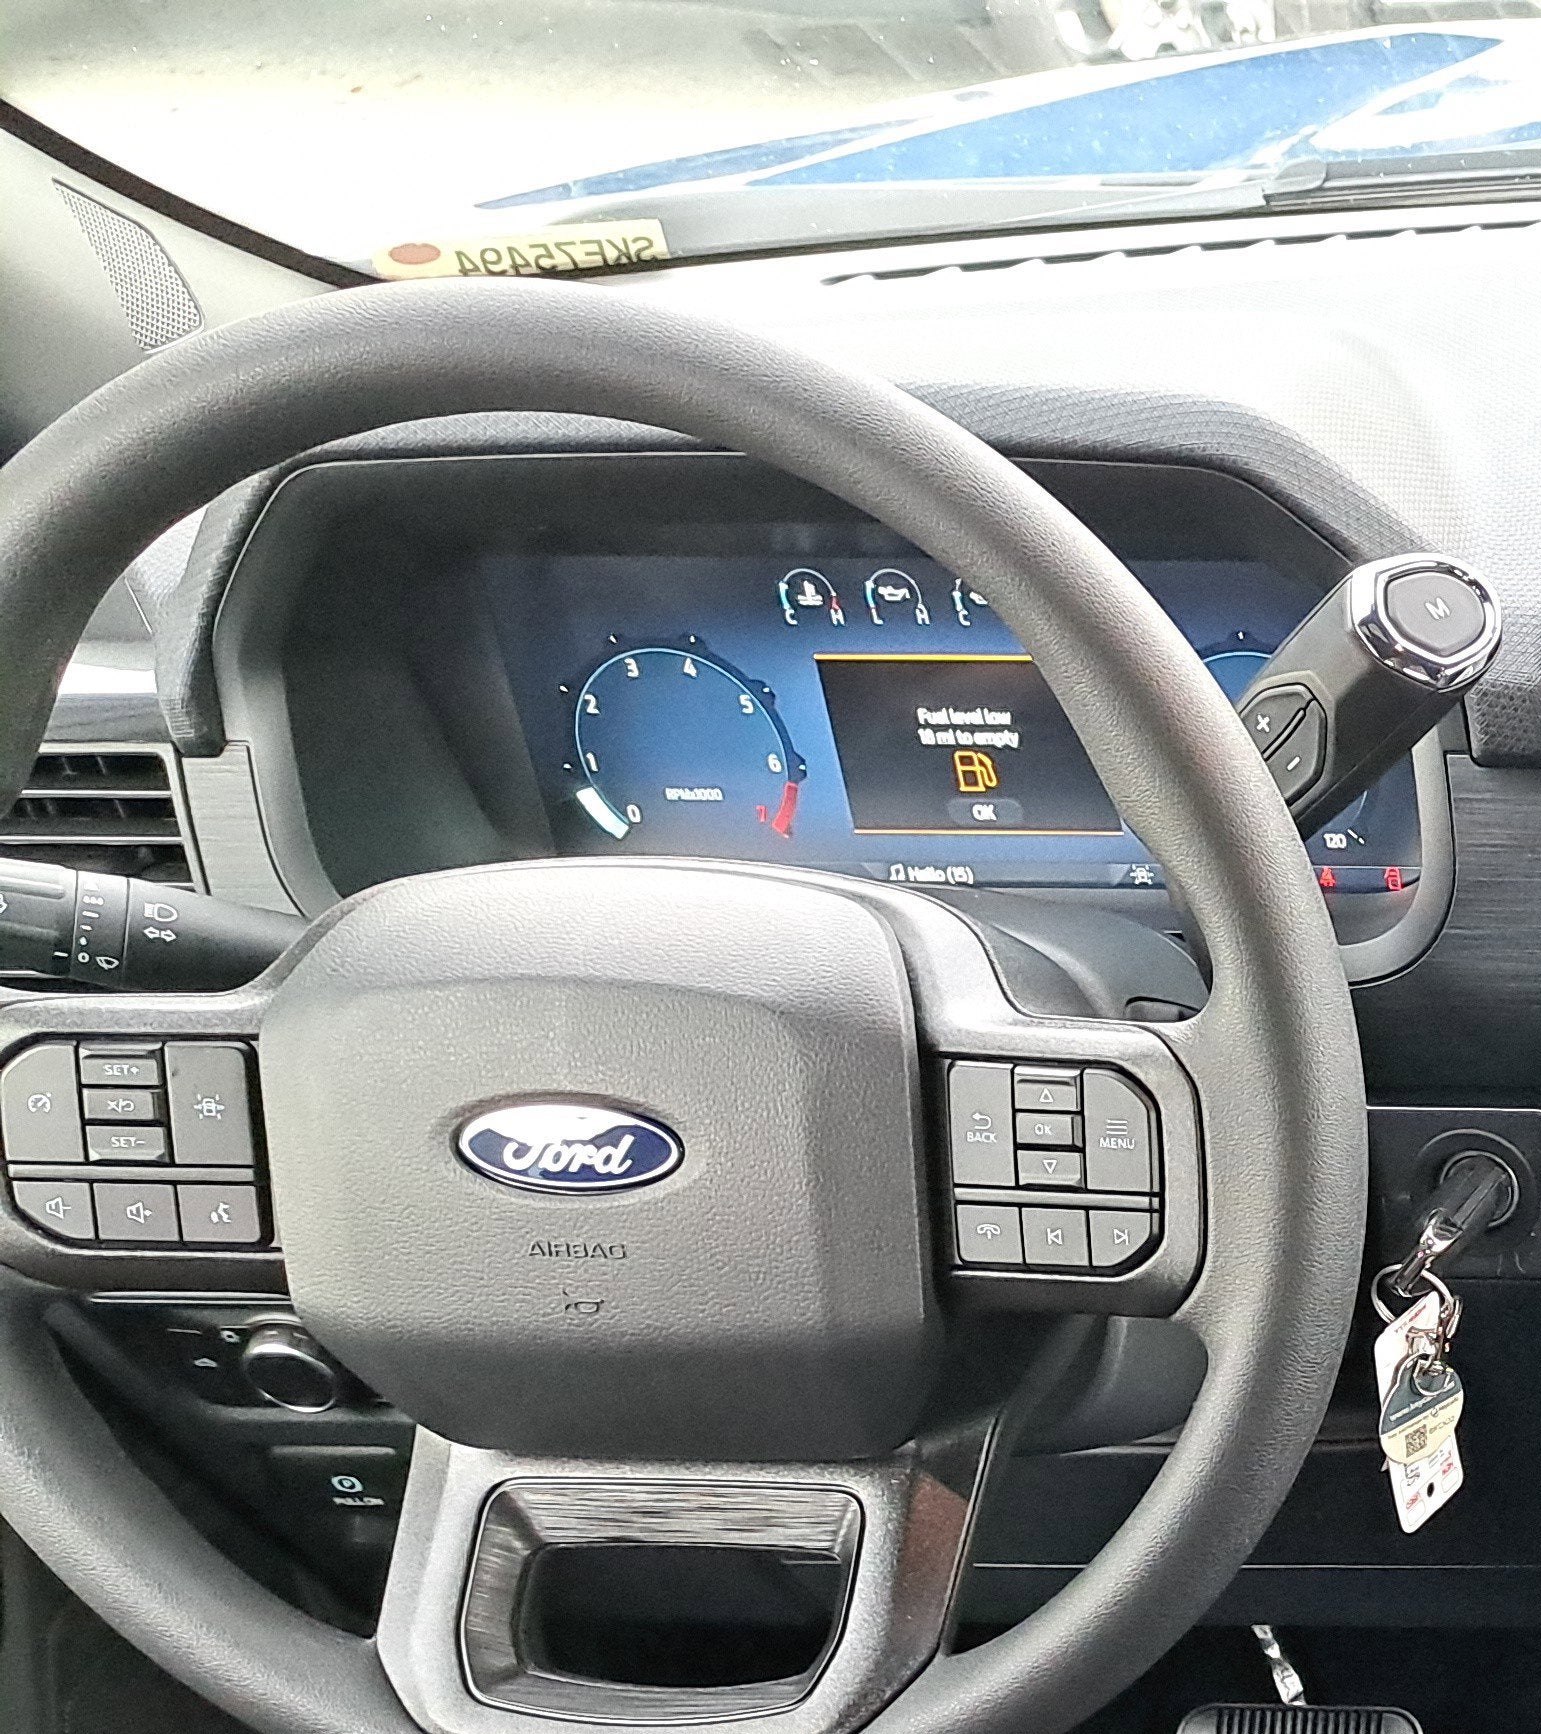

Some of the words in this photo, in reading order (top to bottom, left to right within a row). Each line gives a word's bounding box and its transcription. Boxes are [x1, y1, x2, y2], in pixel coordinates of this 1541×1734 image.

[1424, 597, 1451, 621] M
[624, 658, 640, 678] 3
[683, 657, 698, 678] 4
[584, 694, 600, 714] 2
[739, 695, 754, 714] 5
[916, 708, 950, 725] Fuel
[984, 708, 1011, 725] low
[956, 730, 973, 745] to
[974, 730, 1019, 748] empty
[586, 753, 598, 772] 1
[767, 754, 782, 773] 6
[627, 804, 641, 823] 0
[756, 805, 767, 822] 7
[972, 804, 997, 821] OK
[1323, 833, 1347, 849] 120
[966, 1131, 997, 1143] BACK
[1034, 1123, 1052, 1136] OK
[1100, 1137, 1135, 1150] MENU
[501, 1132, 635, 1175] Ford
